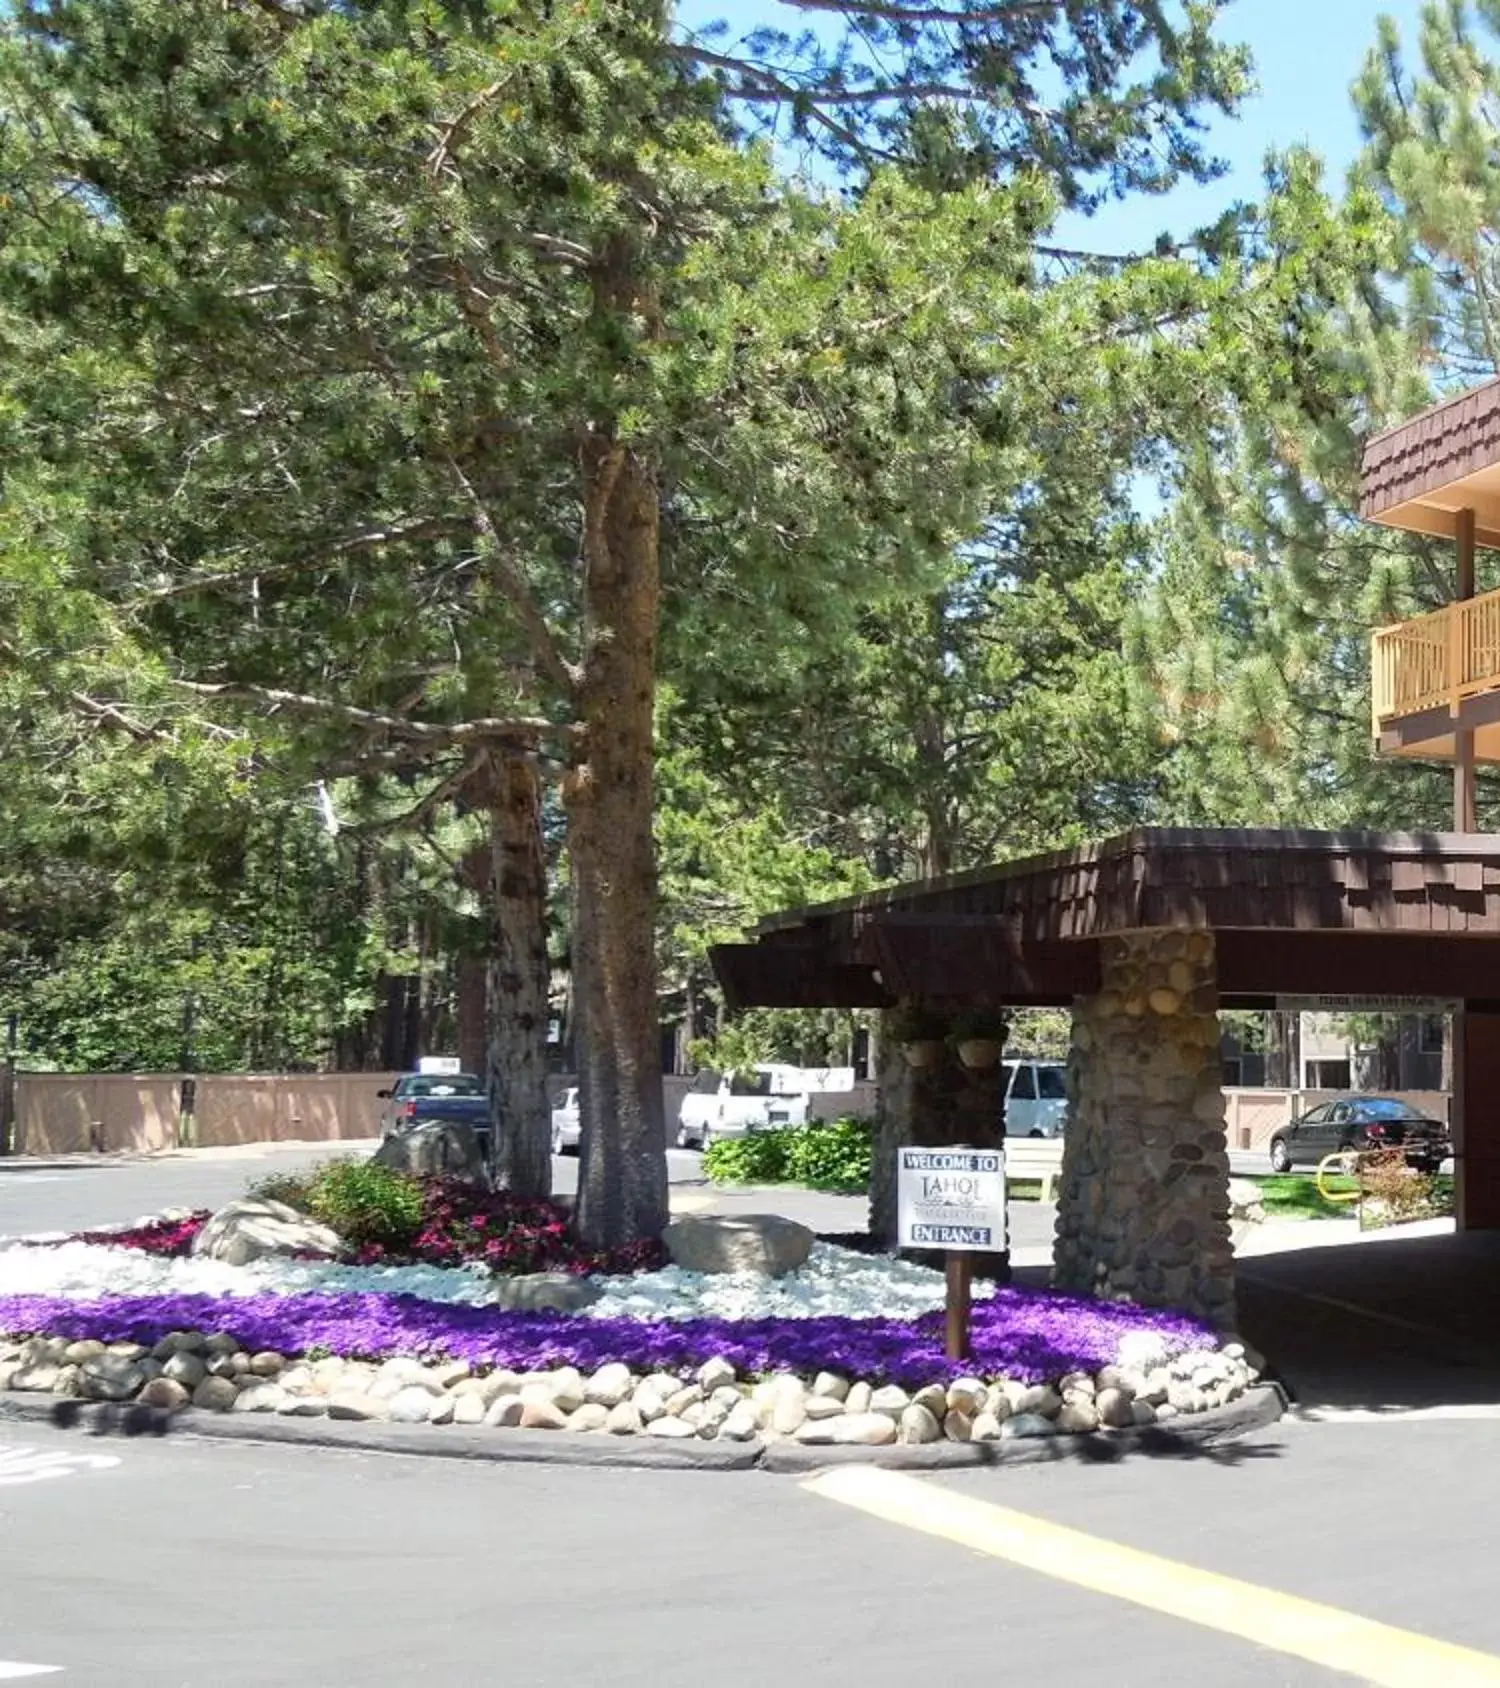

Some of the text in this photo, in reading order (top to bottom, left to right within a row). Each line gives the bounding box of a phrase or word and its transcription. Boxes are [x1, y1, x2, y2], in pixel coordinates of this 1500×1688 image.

[906, 1154, 995, 1171] WELCOME TO
[914, 1226, 987, 1243] ENTRANCE
